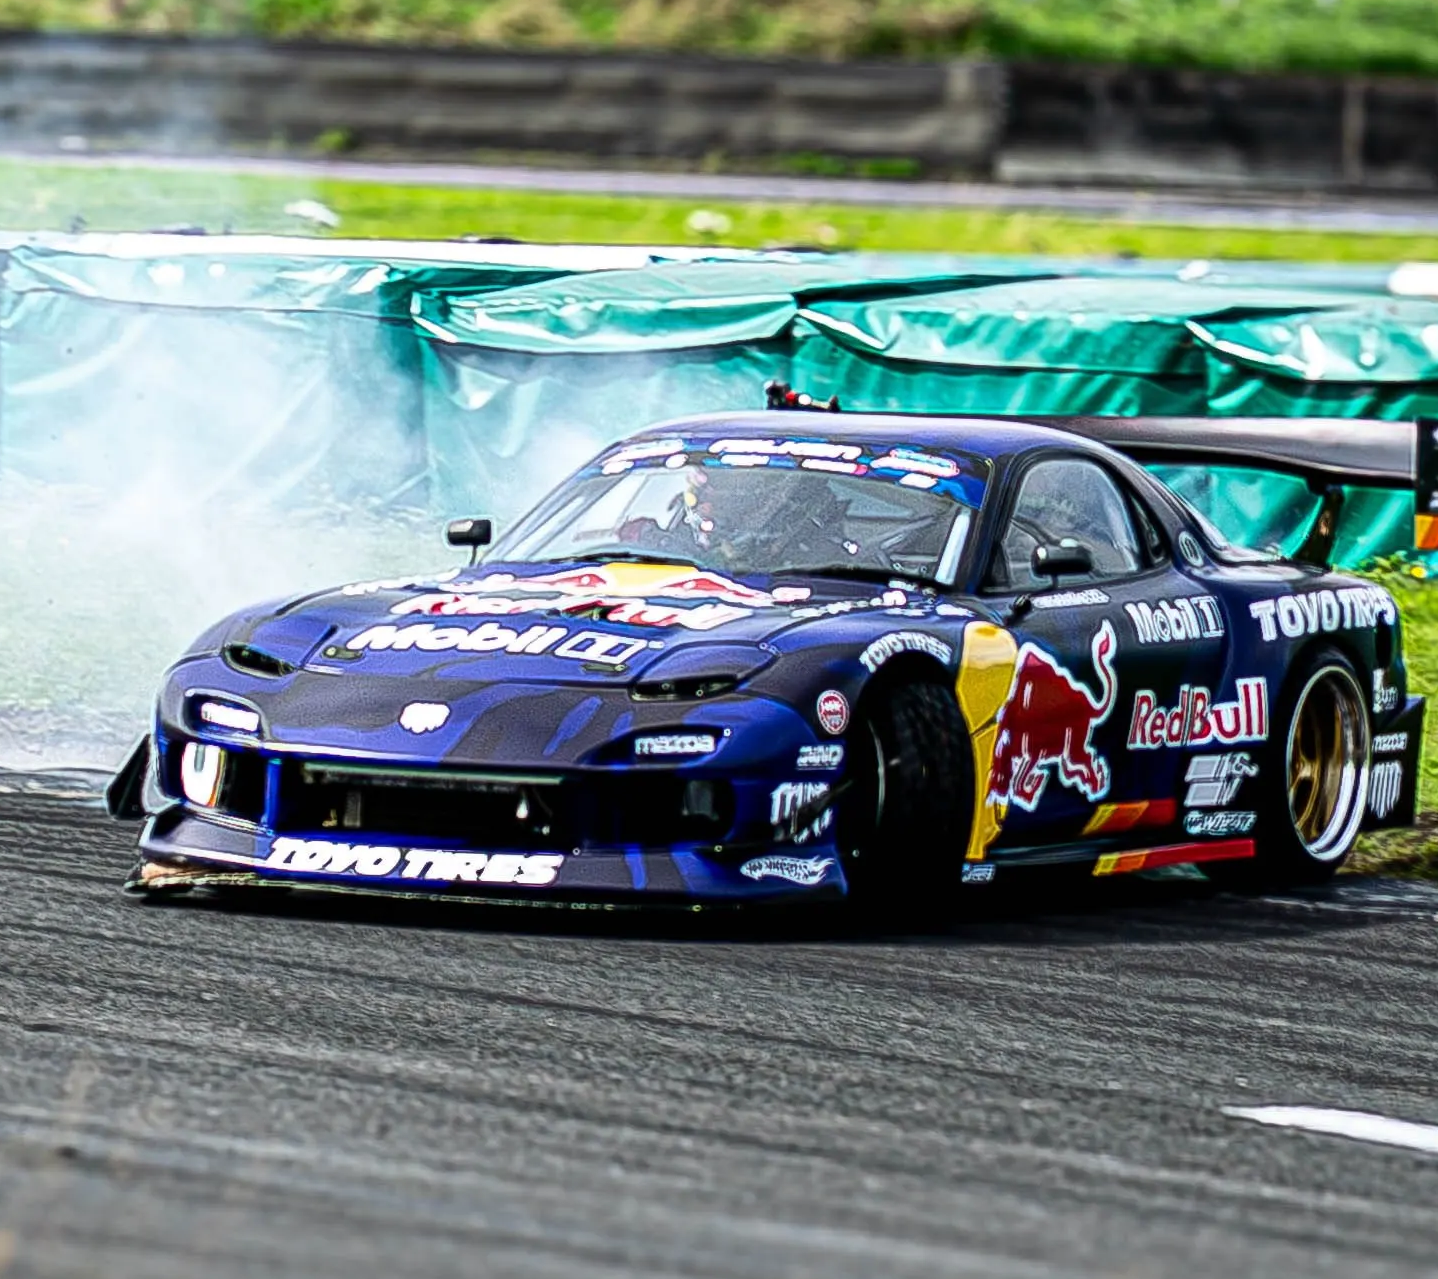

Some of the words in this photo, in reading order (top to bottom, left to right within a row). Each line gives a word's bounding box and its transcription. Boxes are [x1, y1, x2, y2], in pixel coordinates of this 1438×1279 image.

[1124, 600, 1196, 644] Mobil
[1249, 590, 1340, 642] TOYO
[347, 623, 566, 655] Mobil
[859, 633, 904, 673] TOYO
[899, 632, 953, 665] TIRES
[264, 837, 401, 876] TOYO
[401, 849, 564, 884] TIRES
